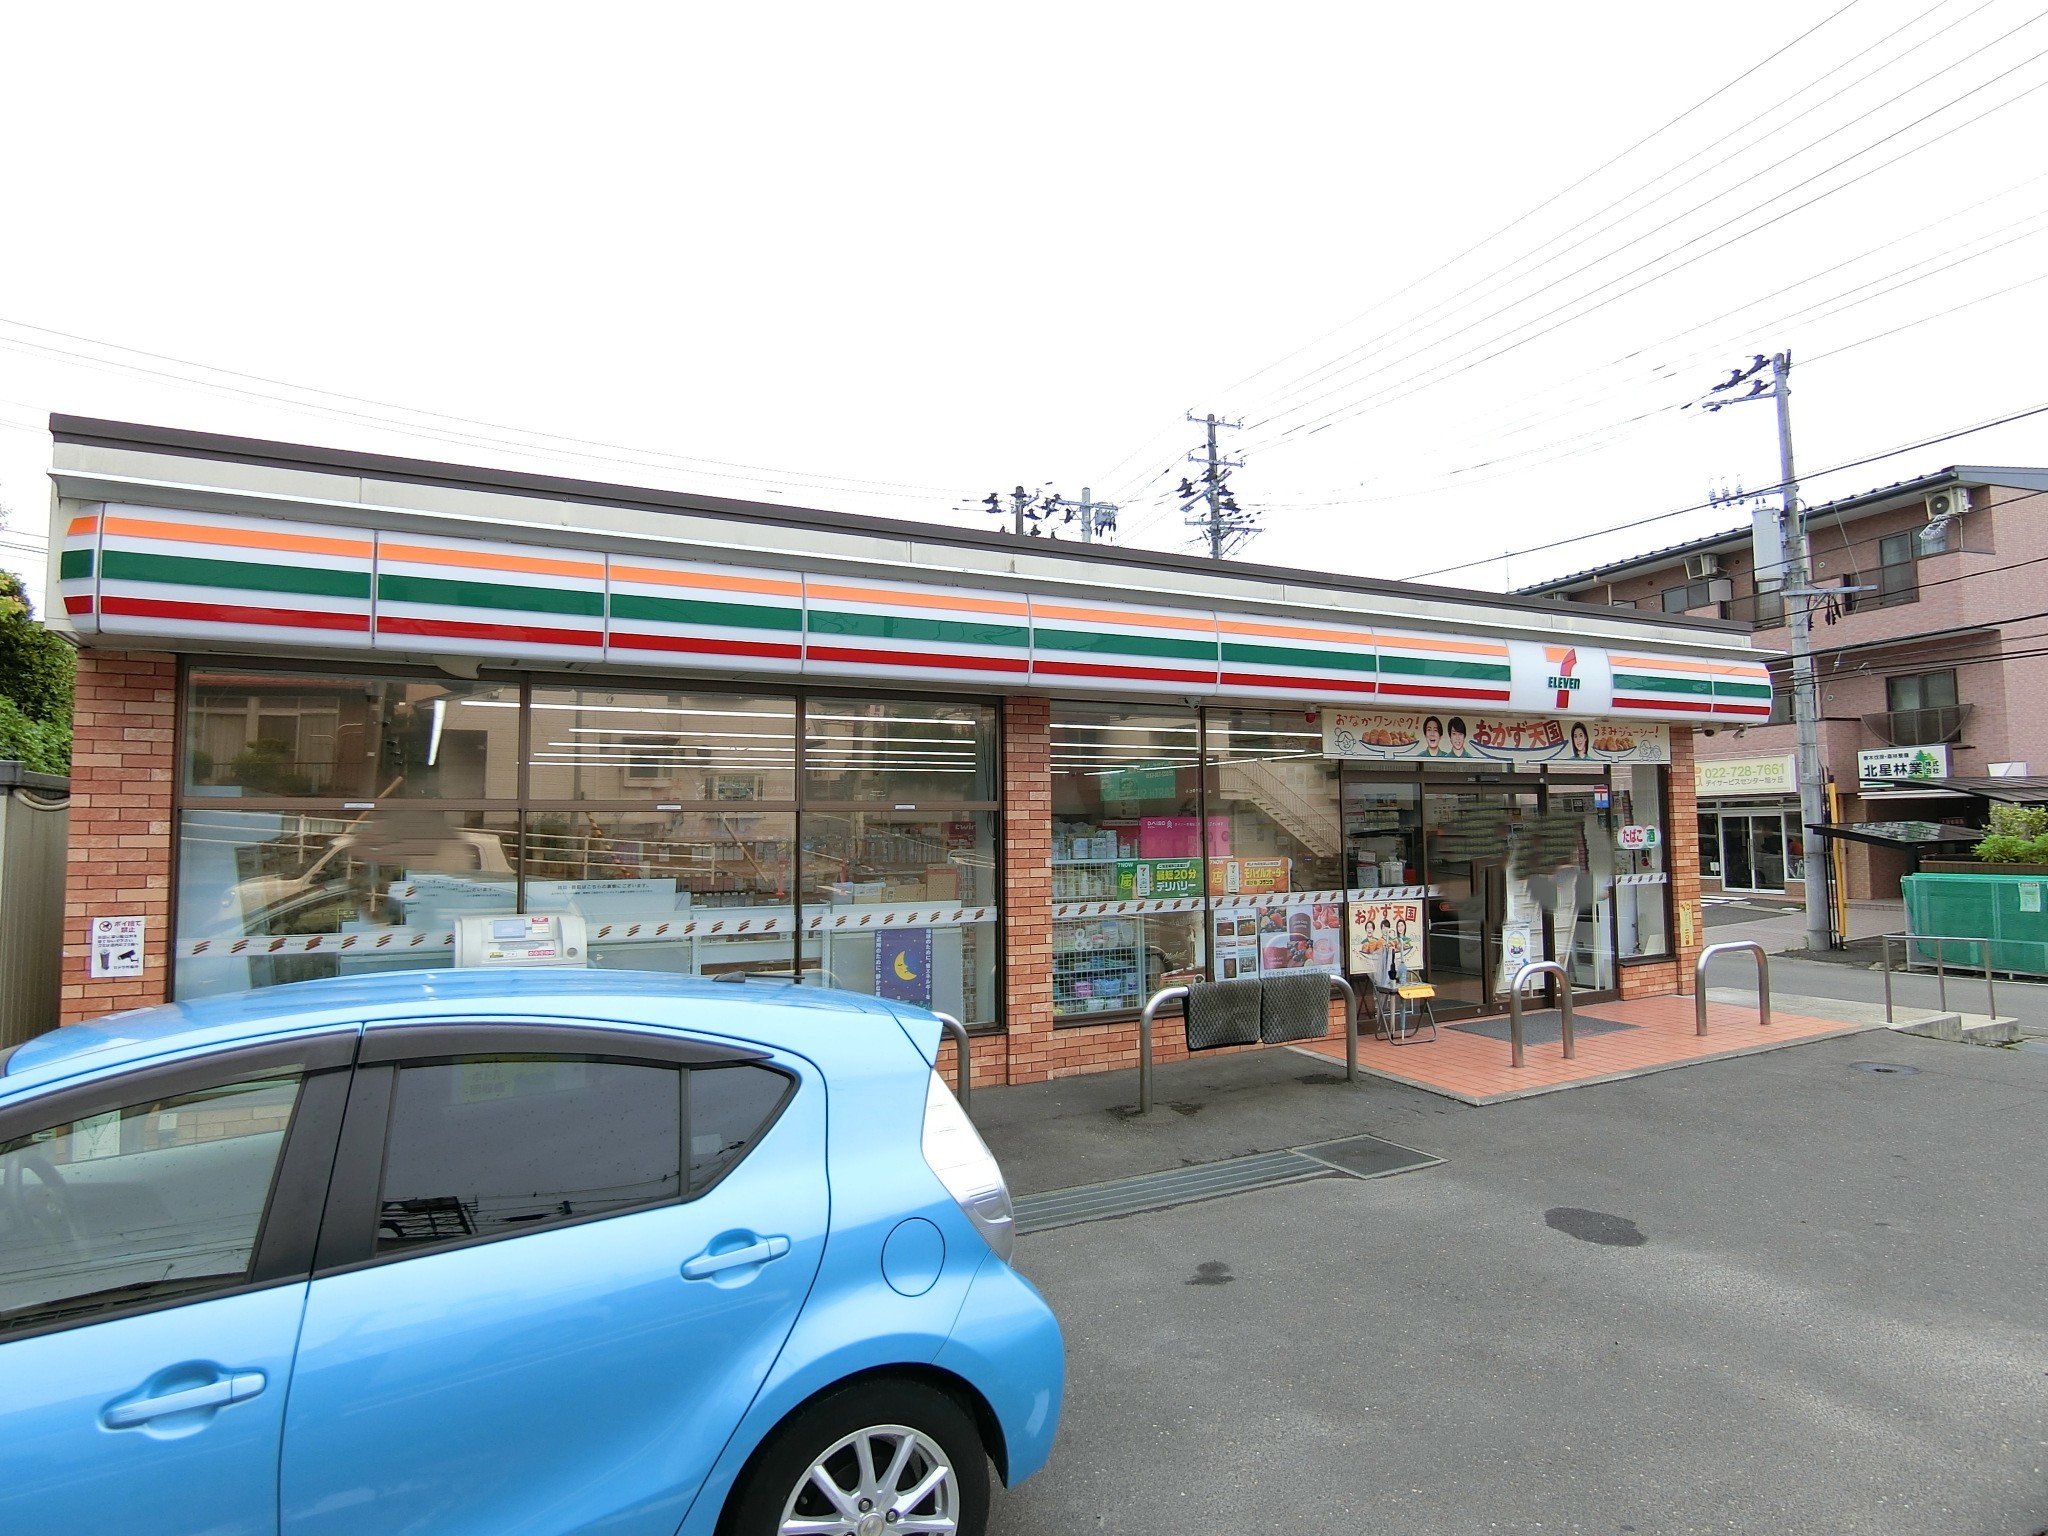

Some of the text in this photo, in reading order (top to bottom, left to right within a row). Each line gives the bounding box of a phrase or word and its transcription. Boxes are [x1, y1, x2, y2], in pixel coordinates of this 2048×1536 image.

[1548, 676, 1581, 691] ELEVEN
[1475, 718, 1563, 749] おかず天国
[1705, 763, 1785, 779] 022-728-7661
[1864, 761, 1923, 778] 北星林業
[1622, 829, 1643, 843] たばこ
[1646, 828, 1656, 843] 酒
[1156, 869, 1197, 881] 最短20分
[1156, 880, 1197, 892] デリバリー
[1354, 902, 1418, 925] おかず天国
